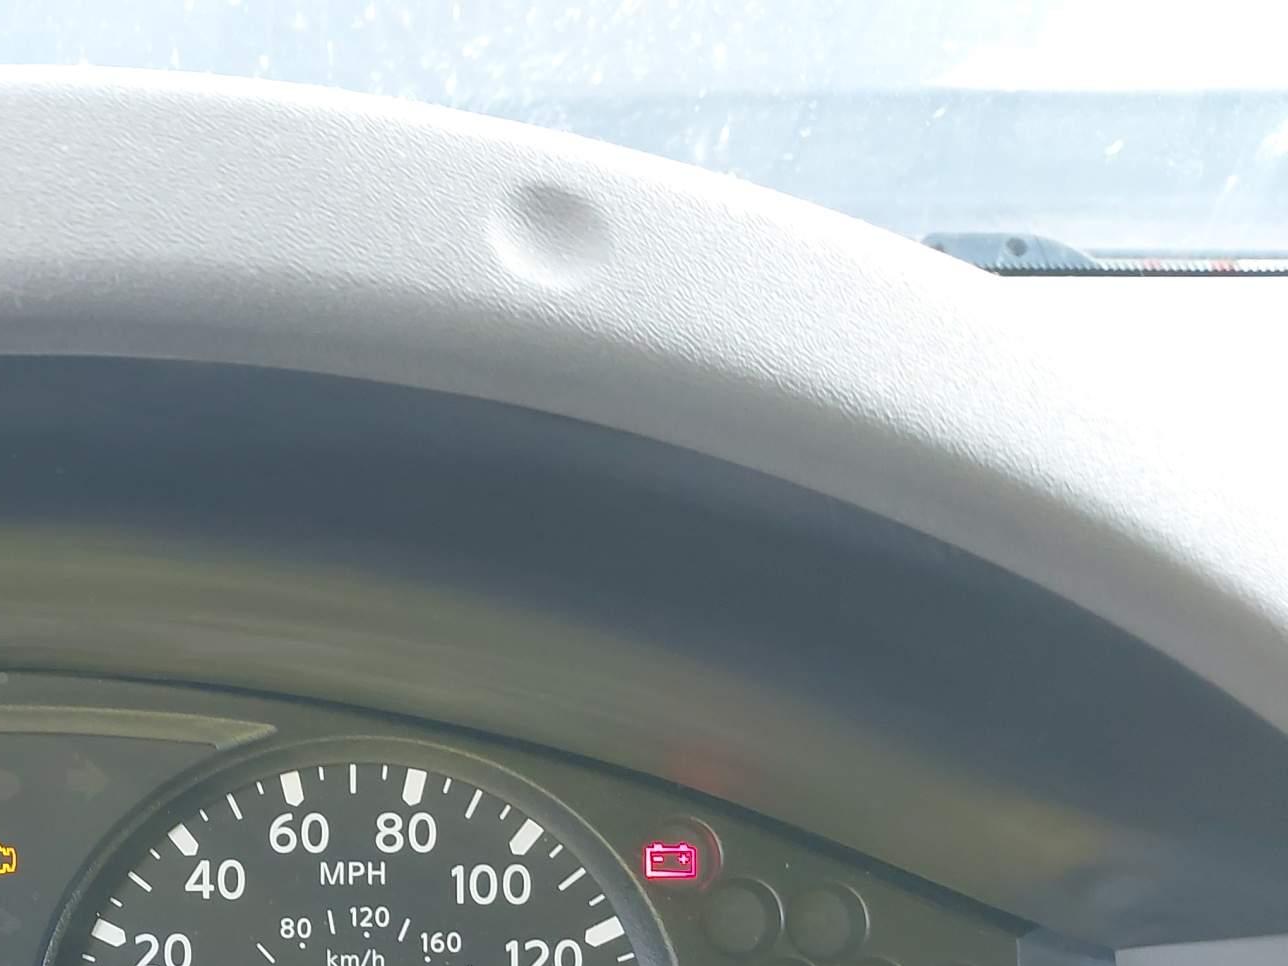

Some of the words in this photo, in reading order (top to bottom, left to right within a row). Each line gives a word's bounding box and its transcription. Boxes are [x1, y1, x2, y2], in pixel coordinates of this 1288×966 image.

[268, 812, 330, 854] 60
[375, 812, 437, 854] 80
[184, 859, 246, 900] 40
[319, 862, 386, 885] MPH
[451, 864, 533, 905] 100
[280, 918, 312, 939] 80
[349, 907, 390, 929] 120
[420, 931, 462, 954] 160
